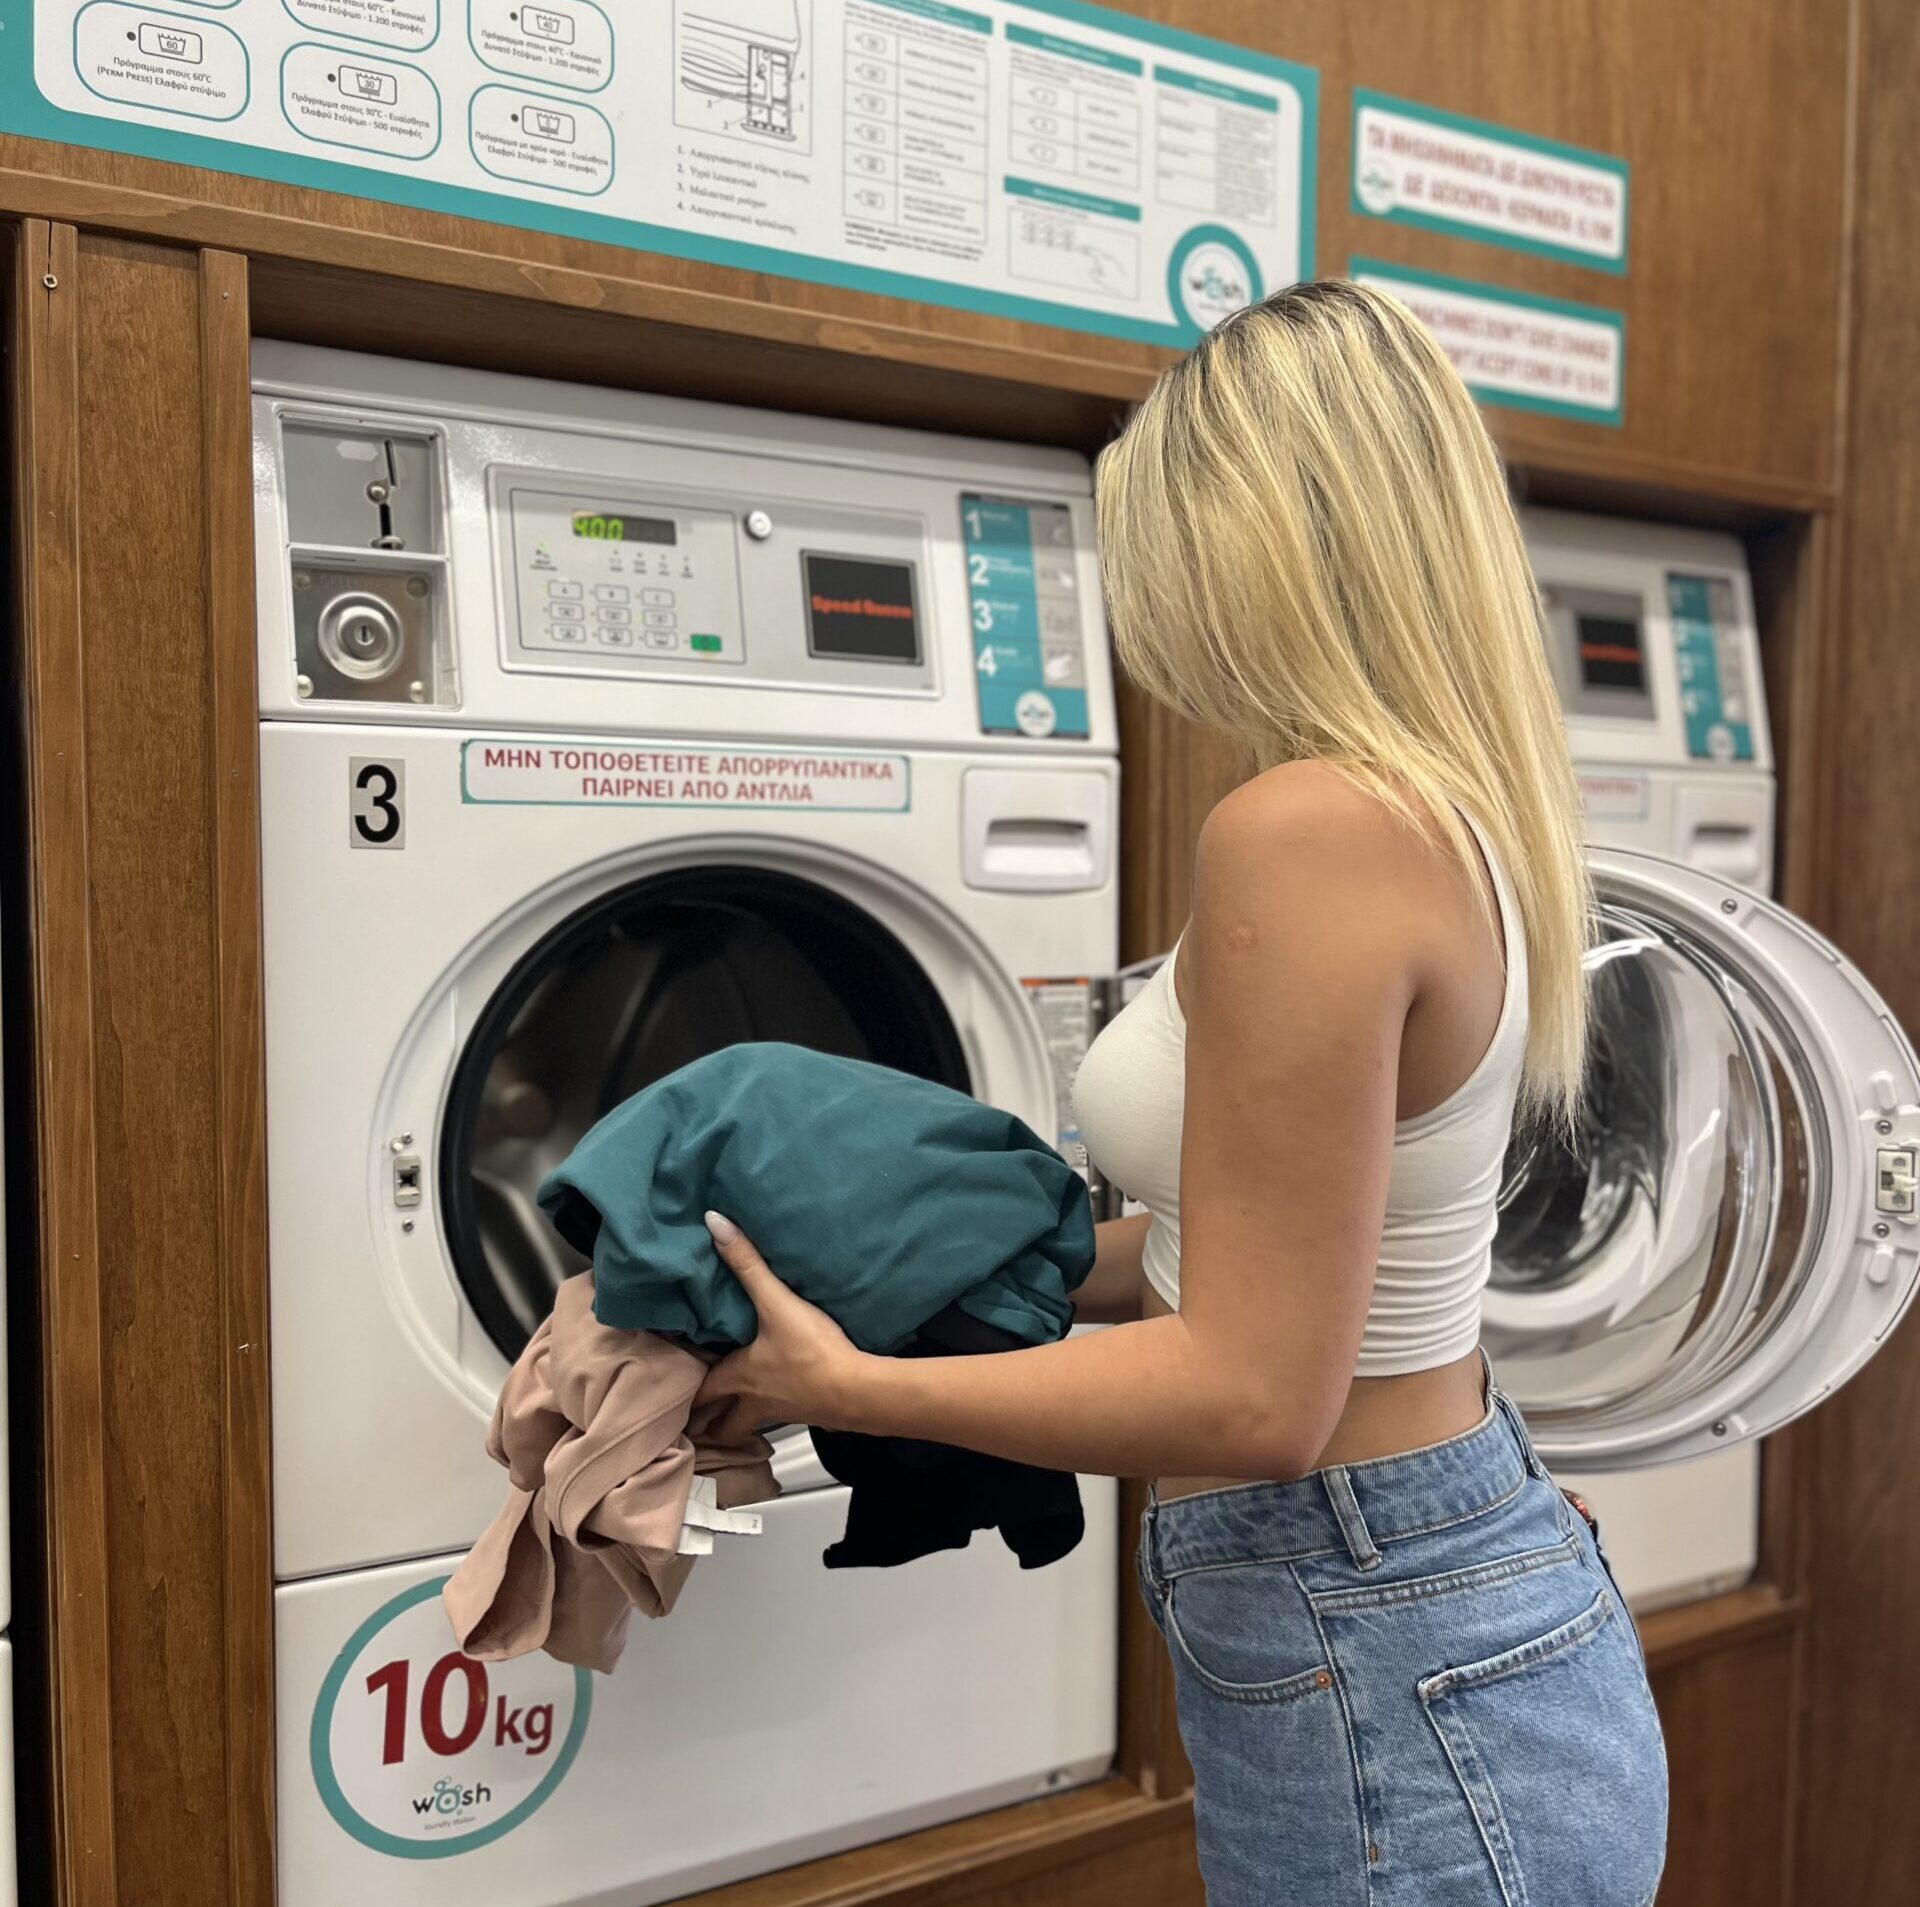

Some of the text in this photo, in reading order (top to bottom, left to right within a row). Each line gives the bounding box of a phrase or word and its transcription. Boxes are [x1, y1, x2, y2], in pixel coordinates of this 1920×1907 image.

[166, 41, 178, 50] 60
[113, 56, 164, 74] Πρόγραμμα
[166, 68, 191, 80] στους
[966, 508, 982, 540] 1
[969, 553, 990, 586] 2
[973, 599, 994, 632] 3
[977, 645, 997, 678] 4
[484, 748, 894, 781] ΜΗΝ ΤΟΠΟΘΕΤΕΙΤΕ ΑΠΟΡΡΥΠΑΝΤΙΚΑ
[355, 764, 400, 843] 3
[582, 778, 814, 802] ΠΑΙΡΝΕΙ ΑΠΟ ΑΝΤΛΙΑ
[366, 1651, 554, 1765] 10 kg
